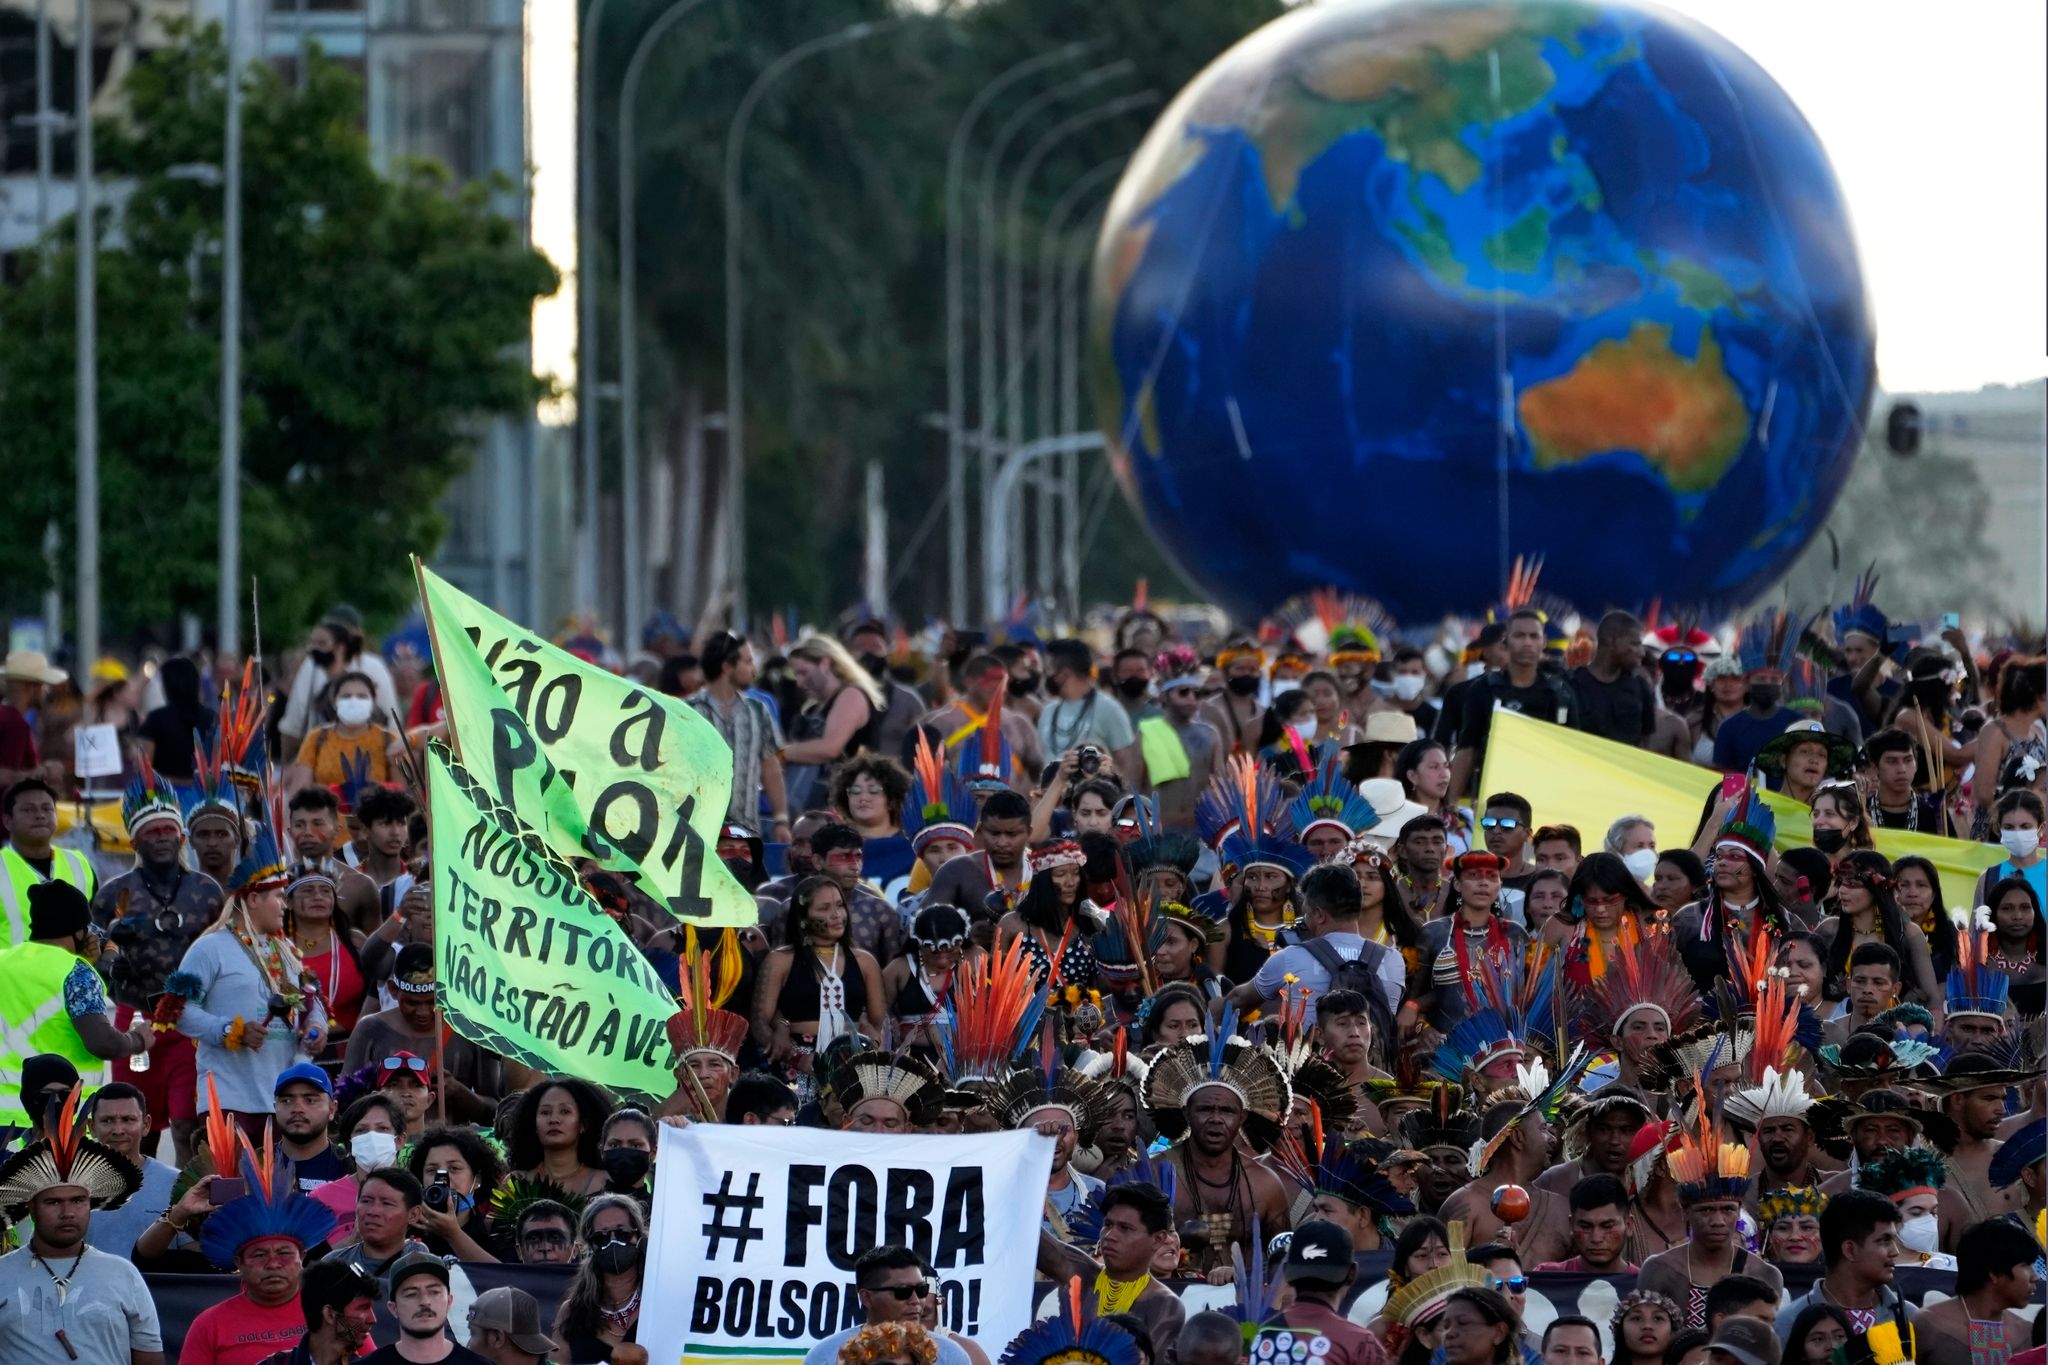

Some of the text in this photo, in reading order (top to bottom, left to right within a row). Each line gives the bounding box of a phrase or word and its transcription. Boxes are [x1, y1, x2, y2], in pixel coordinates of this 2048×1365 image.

[461, 816, 604, 916] NOSSO
[444, 934, 487, 1006] NÃO
[491, 982, 590, 1049] ESTÃO
[587, 992, 621, 1056] À
[784, 1164, 985, 1272] FORA
